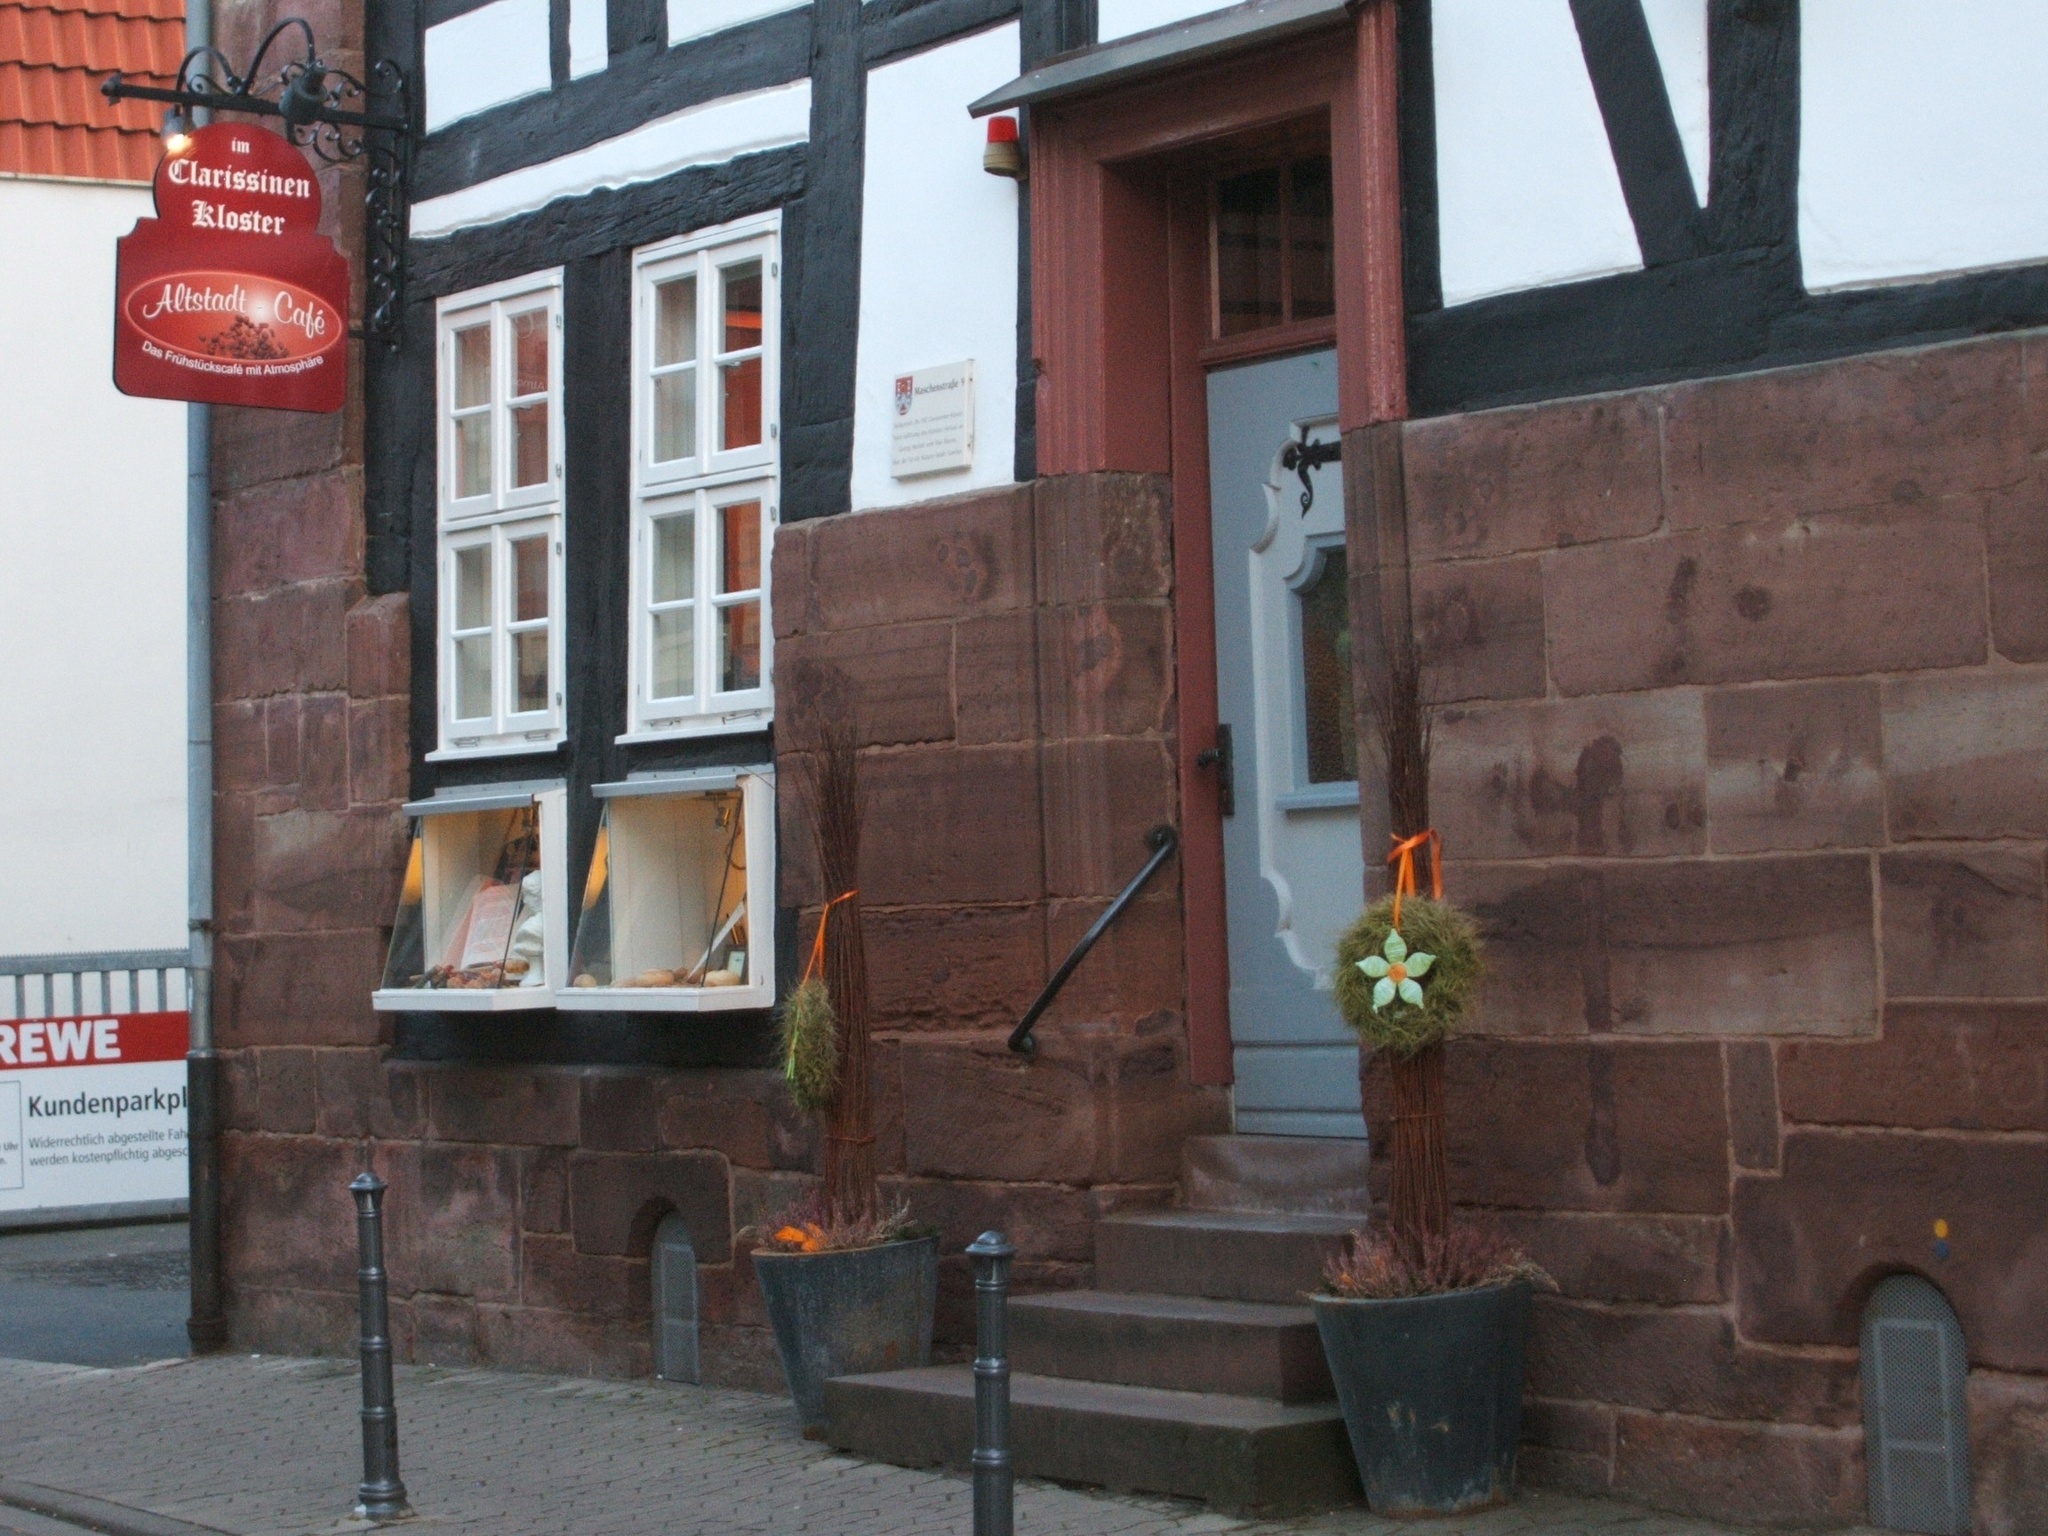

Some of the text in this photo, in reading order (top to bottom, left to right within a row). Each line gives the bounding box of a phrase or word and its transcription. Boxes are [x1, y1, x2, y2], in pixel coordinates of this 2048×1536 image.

[231, 137, 250, 154] im
[168, 158, 311, 198] Clarissinen
[192, 200, 285, 235] Kloster
[142, 283, 247, 319] Altstadt
[273, 291, 325, 338] Café
[141, 340, 324, 376] Das Frühstückscafé mit Atmosphäre
[0, 1018, 122, 1064] REWE
[28, 1085, 187, 1118] Kundenparkpl
[28, 1133, 105, 1149] Widerrechtlich
[107, 1130, 165, 1146] abgestellte
[29, 1153, 70, 1167] werden
[71, 1147, 149, 1164] kostenpflichtig
